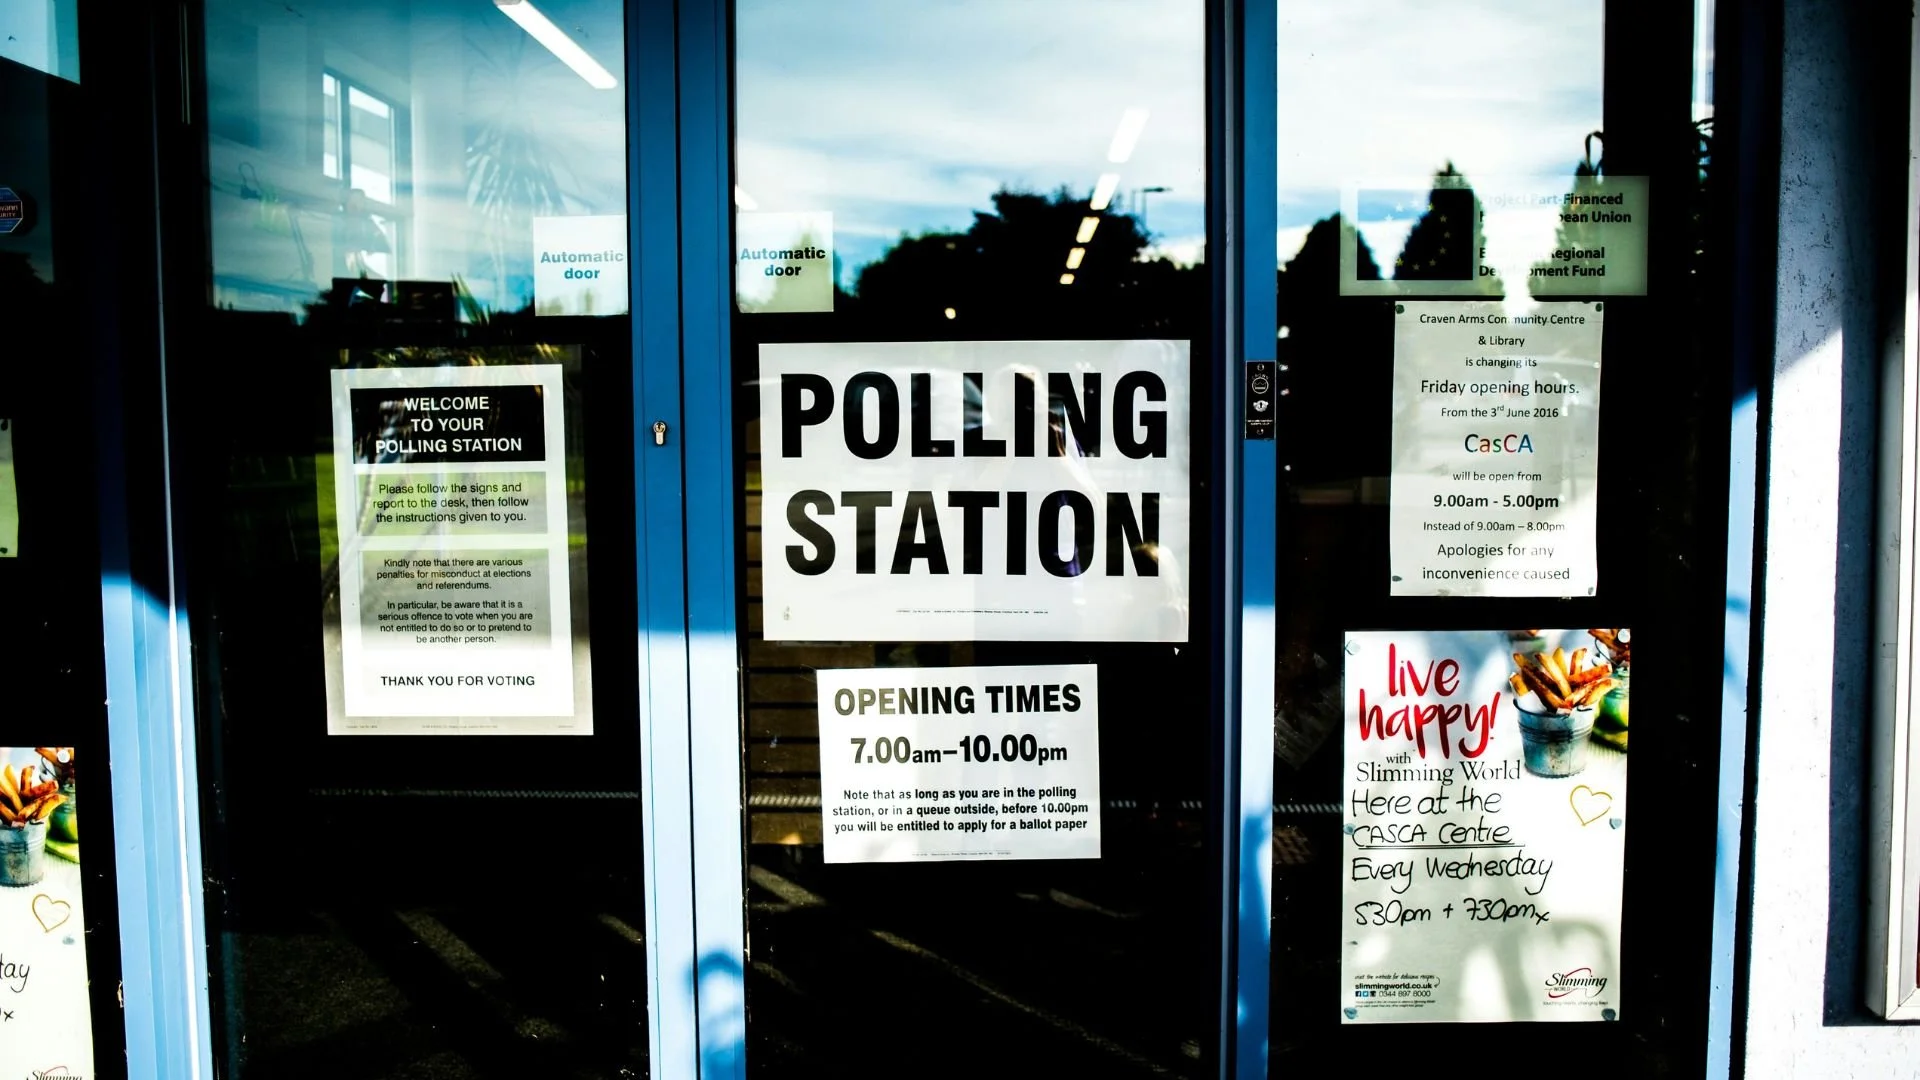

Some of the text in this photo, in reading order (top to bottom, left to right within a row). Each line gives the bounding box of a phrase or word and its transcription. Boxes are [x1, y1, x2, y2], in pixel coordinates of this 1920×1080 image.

[1591, 211, 1631, 224] Union
[540, 250, 624, 264] Automatic
[740, 247, 826, 260] Automatic
[564, 268, 600, 280] door
[764, 264, 801, 276] door
[1572, 265, 1605, 277] Fund
[1420, 314, 1455, 324] Craven
[1458, 314, 1485, 324] Arms
[1550, 315, 1585, 324] Centre
[1478, 336, 1525, 347] & Library
[1466, 358, 1537, 368] is changing its
[1421, 380, 1579, 396] Friday opening hours.
[404, 396, 489, 411] WELCOME
[780, 370, 1167, 460] POLLING
[1441, 408, 1467, 417] From
[1471, 408, 1487, 417] the
[1506, 408, 1530, 418] June
[1533, 408, 1558, 417] 2016
[411, 418, 484, 432] TO YOUR
[376, 438, 522, 454] POLLING STATION
[1465, 434, 1533, 453] CasCA
[1453, 472, 1541, 483] will be open from
[379, 482, 522, 494] Please follow the signs and
[373, 497, 529, 510] report to the desk, then follow
[1434, 495, 1559, 510] 9.00am 5.00pm
[376, 512, 526, 524] the instructions given to you.
[785, 489, 1160, 578] STATION
[1423, 522, 1565, 533] Instead of 9.00am 8.00pm
[1437, 543, 1554, 558] Apologies for any
[384, 559, 410, 569] Kindly
[452, 558, 473, 566] there
[492, 558, 523, 566] various
[377, 570, 415, 580] penalties
[417, 570, 428, 578] for
[431, 570, 480, 578] misconduct
[1423, 567, 1570, 579] inconvenience caused
[417, 581, 491, 590] and referendums.
[387, 601, 395, 609] In
[398, 601, 439, 611] particular,
[378, 612, 408, 620] serious
[411, 612, 442, 620] offence
[476, 612, 498, 620] when
[501, 613, 517, 622] you
[396, 624, 427, 632] entitled
[440, 624, 451, 632] do
[489, 623, 521, 633] pretend
[430, 635, 496, 645] another person.
[1389, 643, 1460, 697] live
[381, 676, 535, 686] THANK YOU FOR VOTING
[834, 684, 1081, 716] OPENING TIMES
[1359, 689, 1501, 759] happy!
[1386, 752, 1411, 764] with
[1356, 760, 1521, 786] Slimming World
[844, 786, 1076, 802] Note that as long as you are in the polling
[1351, 785, 1501, 817] Here at the
[833, 806, 874, 817] station,
[878, 807, 890, 815] or
[893, 806, 902, 815] in
[916, 806, 950, 817] queue
[954, 804, 998, 815] outside,
[1002, 804, 1037, 814] before
[1042, 803, 1088, 815] 10.00pm
[834, 819, 1087, 834] you will be entitled to apply for a ballot paper
[1352, 816, 1512, 847] CASCA Centre
[1352, 850, 1552, 895] Every Wednesday
[1355, 900, 1431, 926] 530pm
